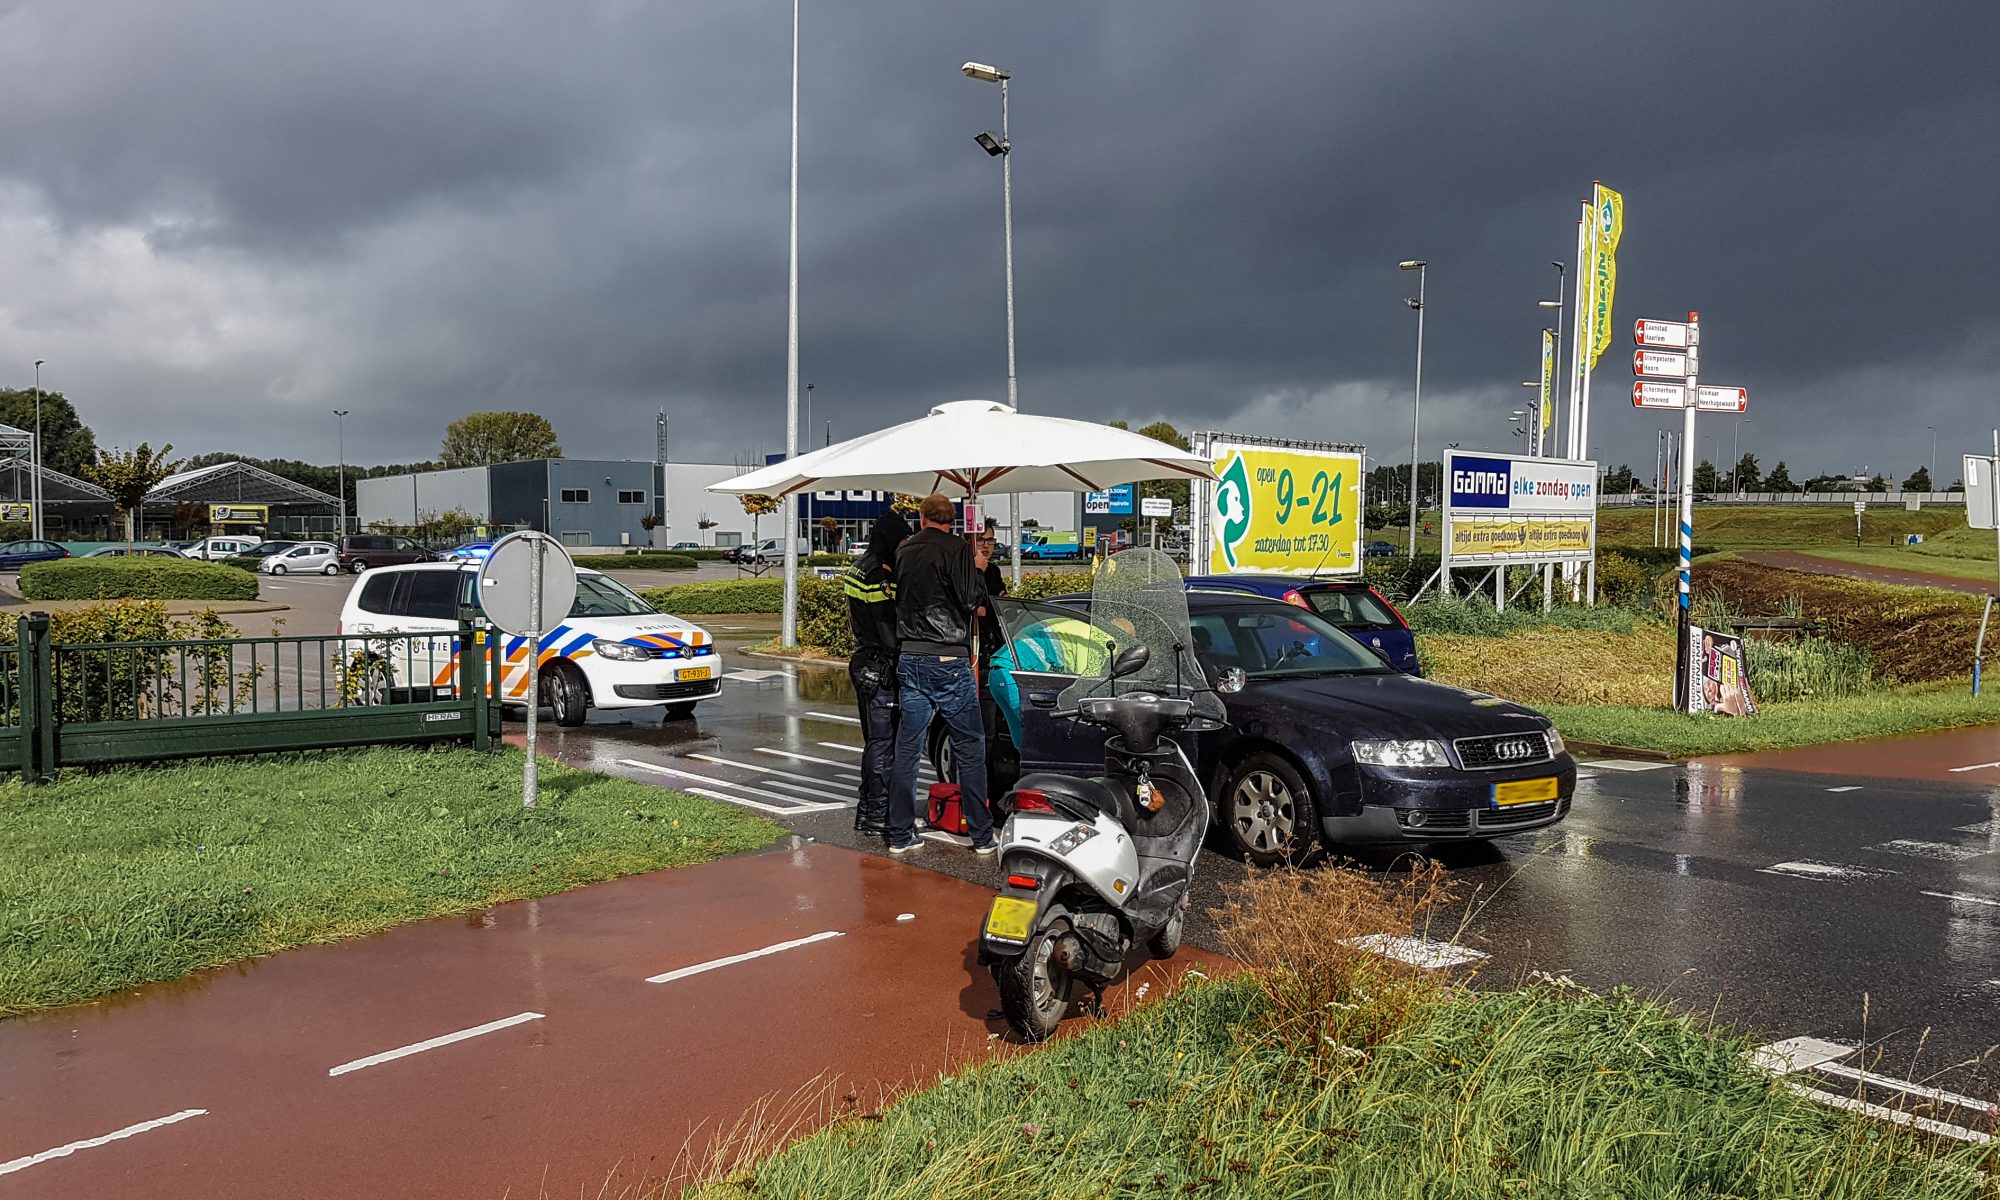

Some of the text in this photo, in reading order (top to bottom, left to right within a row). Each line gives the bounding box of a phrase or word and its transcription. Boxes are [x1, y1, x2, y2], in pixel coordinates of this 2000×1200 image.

[1645, 323, 1668, 332] Zaanstad
[1645, 334, 1666, 342] Haarlem
[1644, 354, 1676, 363] Stompetoren
[1643, 385, 1677, 394] Schermerhorn
[1700, 389, 1719, 397] Alkmaar
[1643, 395, 1669, 404] Purmerend
[1699, 399, 1736, 408] Heerhugowaard
[1257, 467, 1276, 486] open
[1514, 476, 1591, 501] elke zondag open
[1276, 468, 1343, 526] 9-21
[1087, 501, 1109, 511] open
[1455, 530, 1518, 545] altijd extra goedkoop
[1529, 529, 1581, 543] altijd extra goedkoop
[1255, 533, 1292, 556] zaterdag
[1294, 534, 1307, 552] tot
[682, 669, 708, 679] GT-931-J
